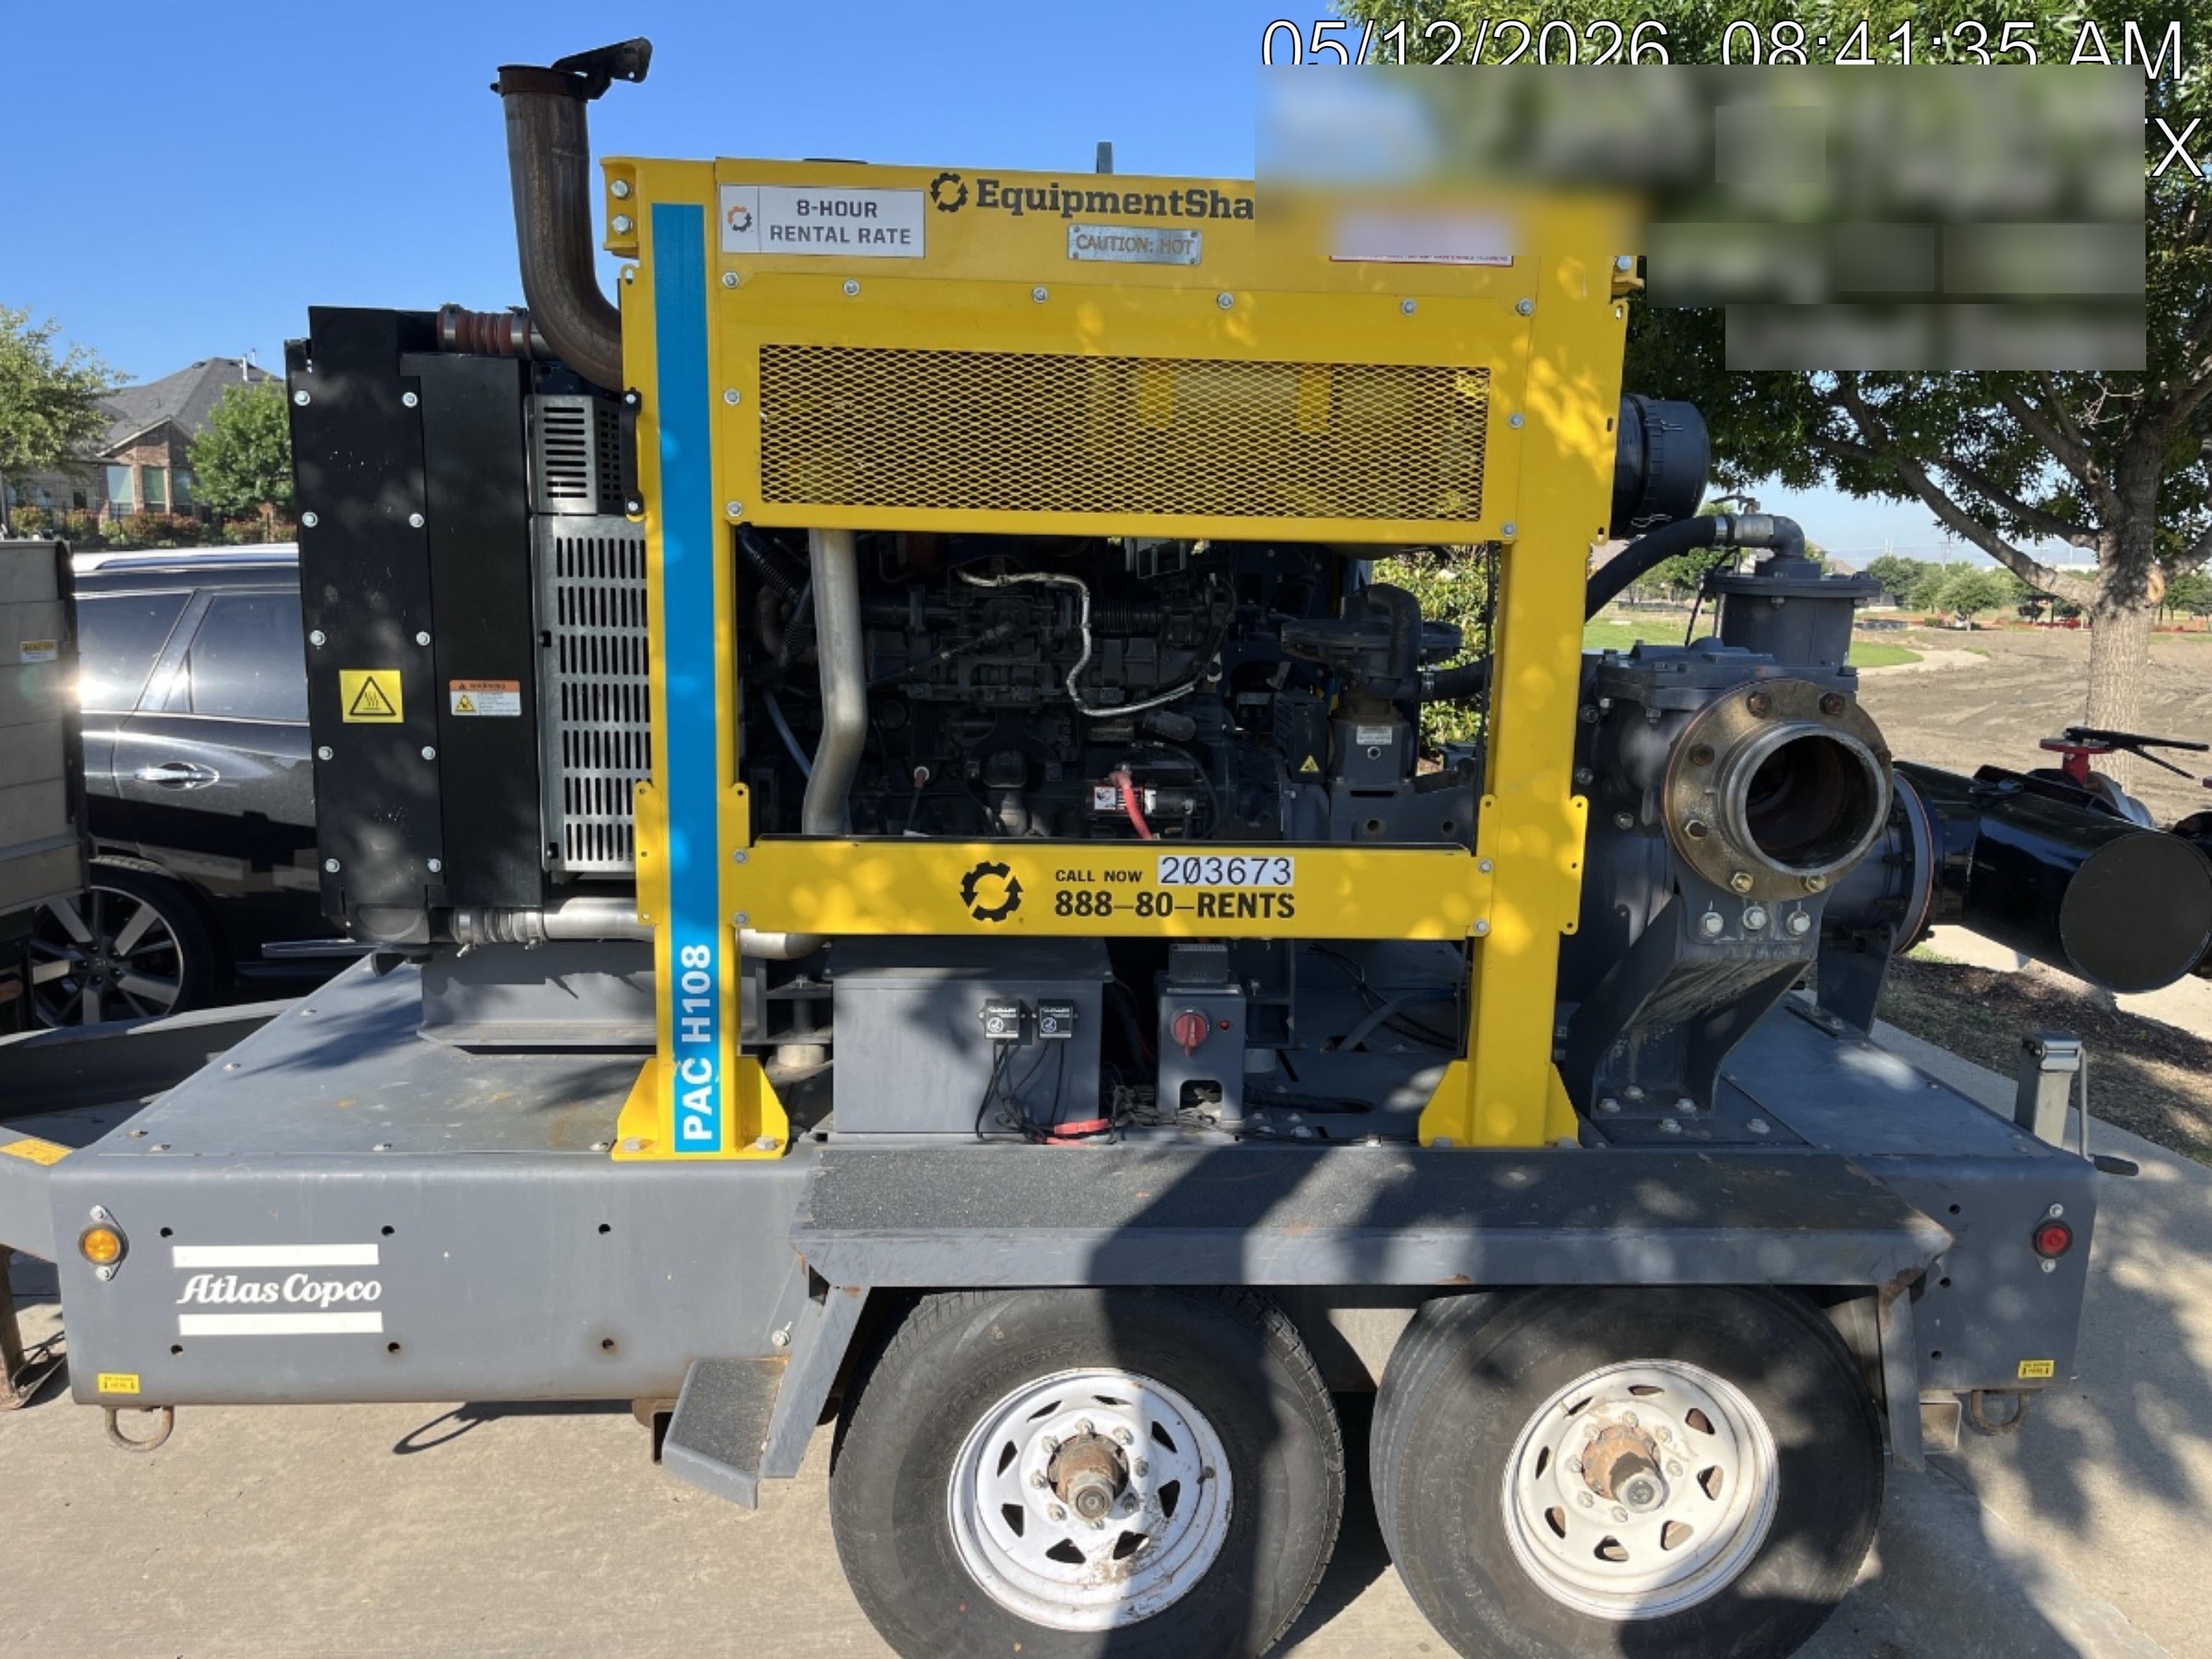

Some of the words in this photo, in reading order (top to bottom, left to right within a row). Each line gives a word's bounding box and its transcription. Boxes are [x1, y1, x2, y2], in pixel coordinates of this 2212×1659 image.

[796, 198, 878, 218] 8-HOUR
[769, 224, 850, 244] RENTAL
[858, 227, 911, 245] RATE
[1160, 238, 1194, 255] HOT
[1055, 869, 1096, 882] CALL
[1104, 870, 1143, 883] NOW
[1160, 857, 1292, 885] 203673
[681, 944, 712, 1043] H108
[681, 1057, 713, 1140] PAC
[175, 1273, 280, 1304] Atlas
[283, 1273, 383, 1308] Copco
